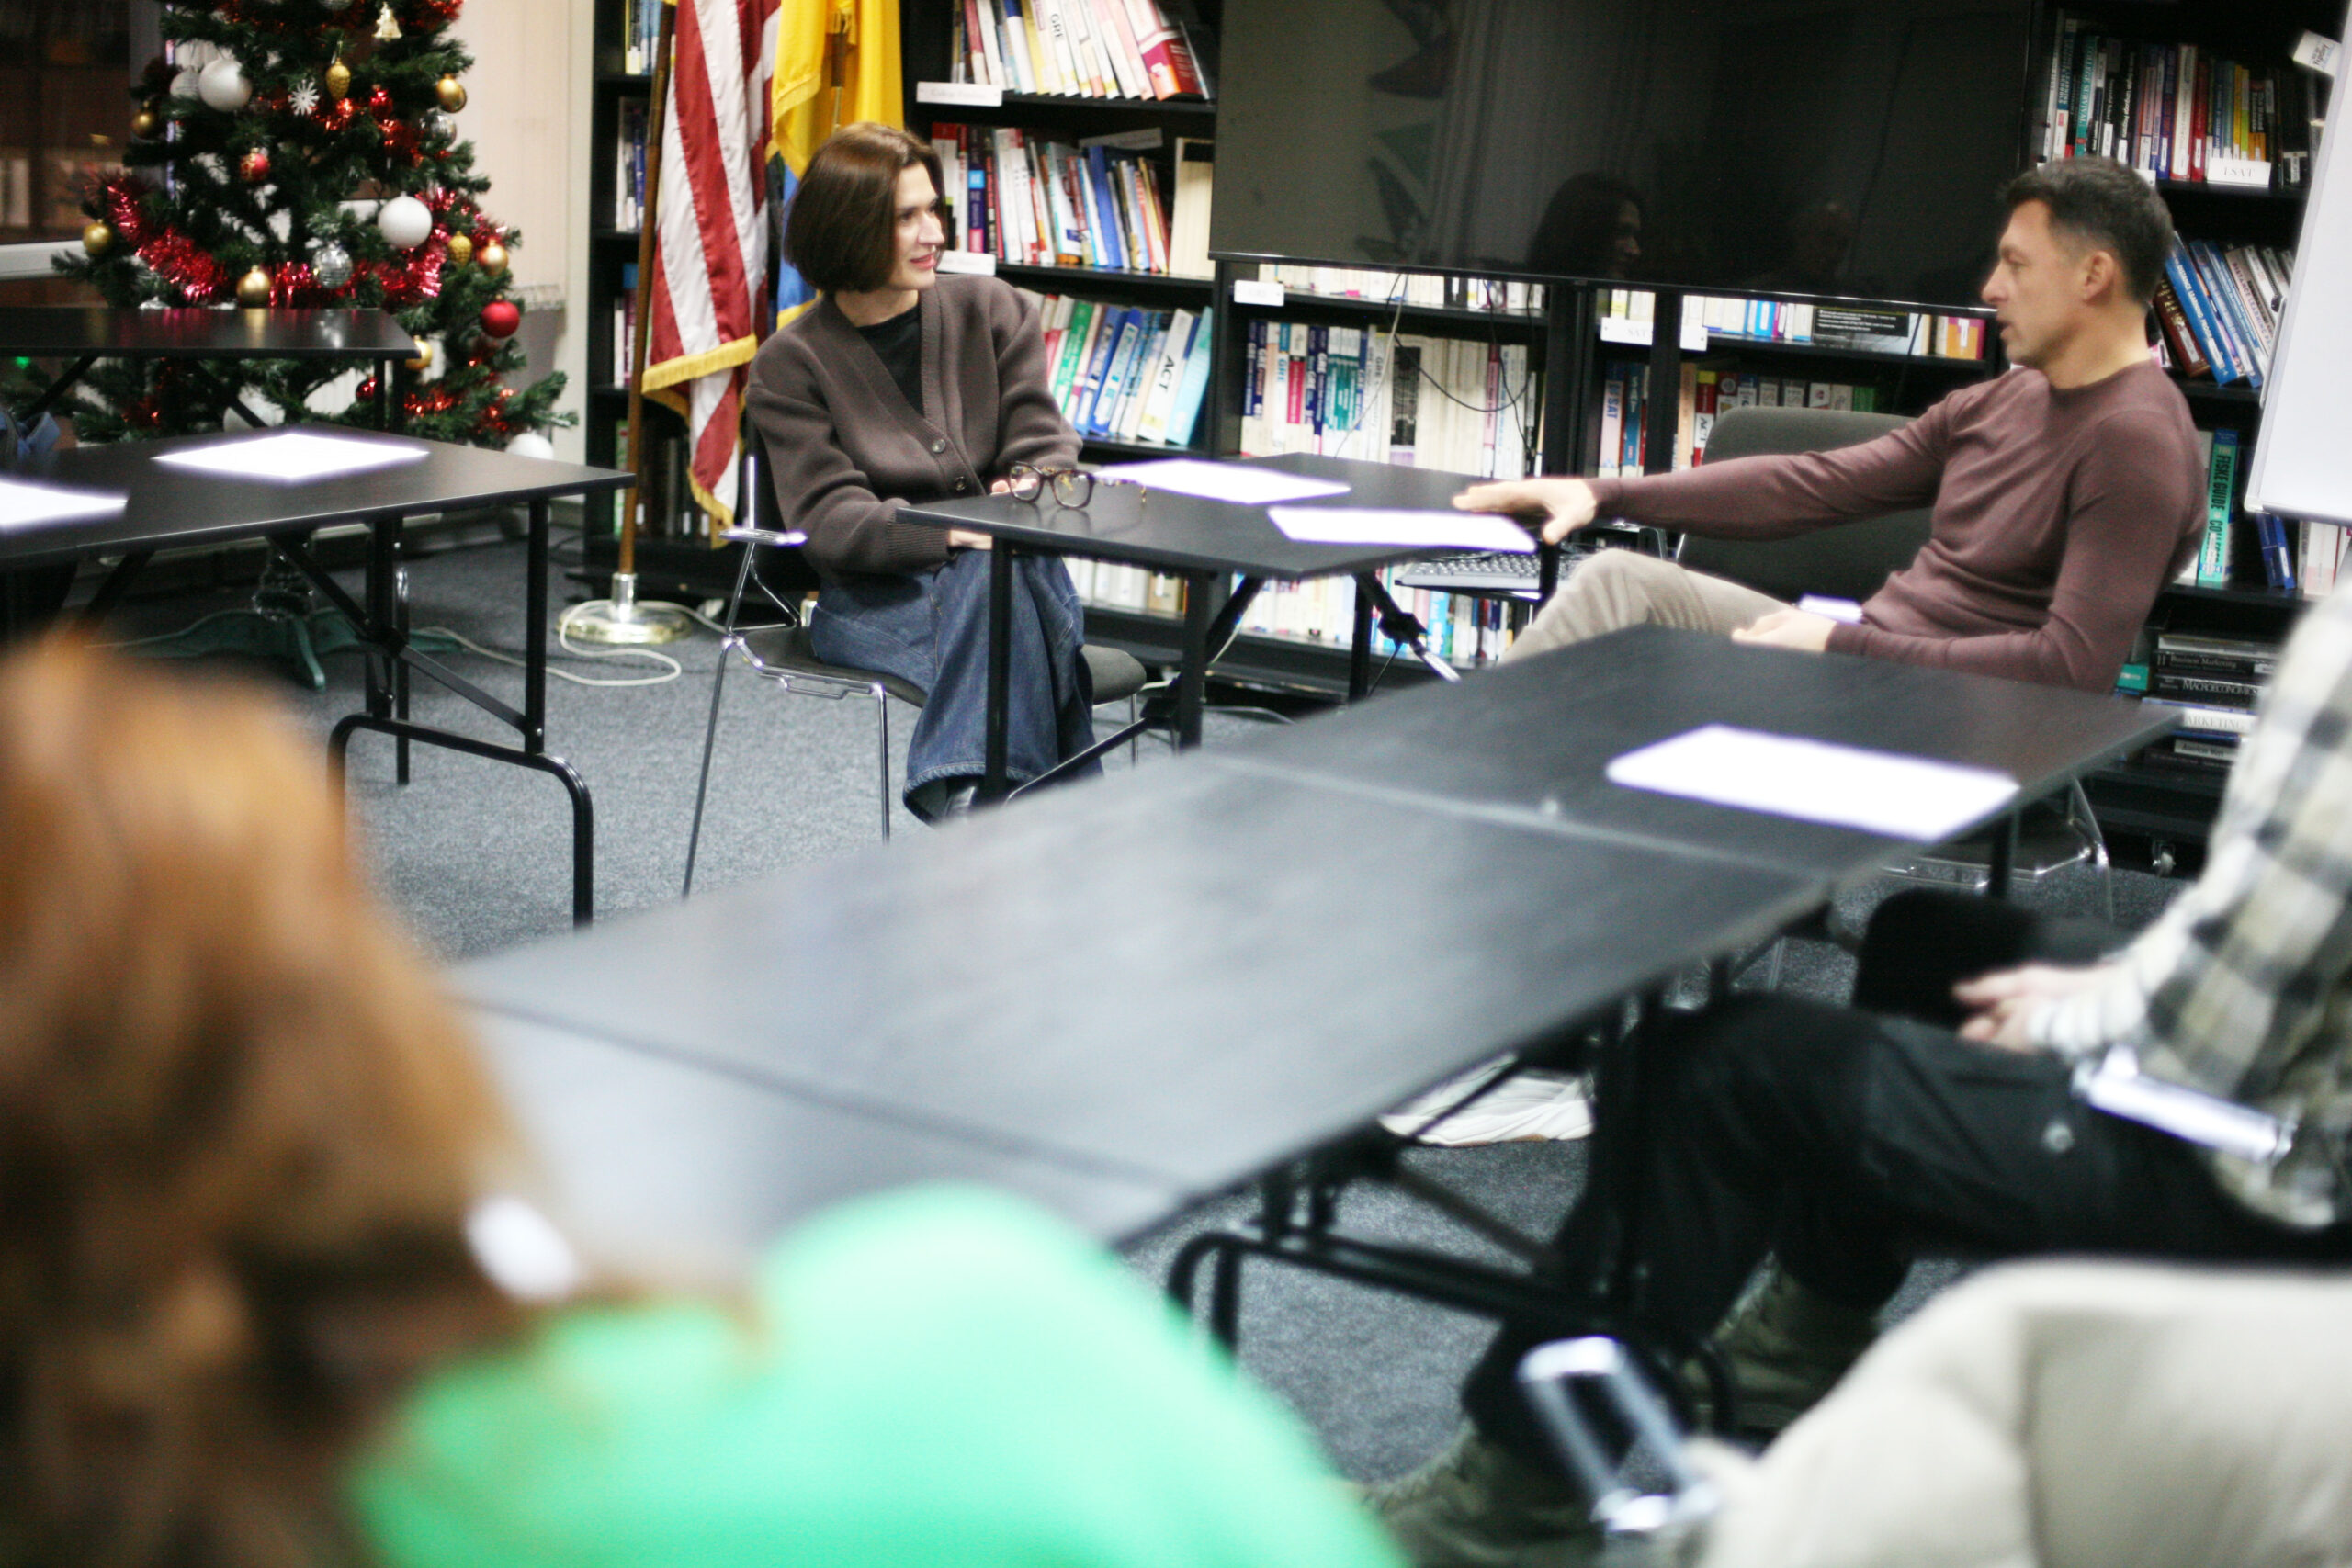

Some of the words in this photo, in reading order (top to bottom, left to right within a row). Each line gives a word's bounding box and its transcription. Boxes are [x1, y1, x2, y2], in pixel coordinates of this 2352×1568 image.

[2079, 84, 2091, 125] SURVIVAL
[2124, 90, 2133, 115] Language
[1157, 355, 1178, 393] ACT
[1277, 358, 1288, 382] GRE
[1317, 352, 1327, 374] GRE
[1606, 398, 1619, 419] SAT
[2214, 455, 2232, 481] FISKE
[2211, 482, 2228, 511] GUIDE
[2187, 715, 2246, 730] ARKETING
